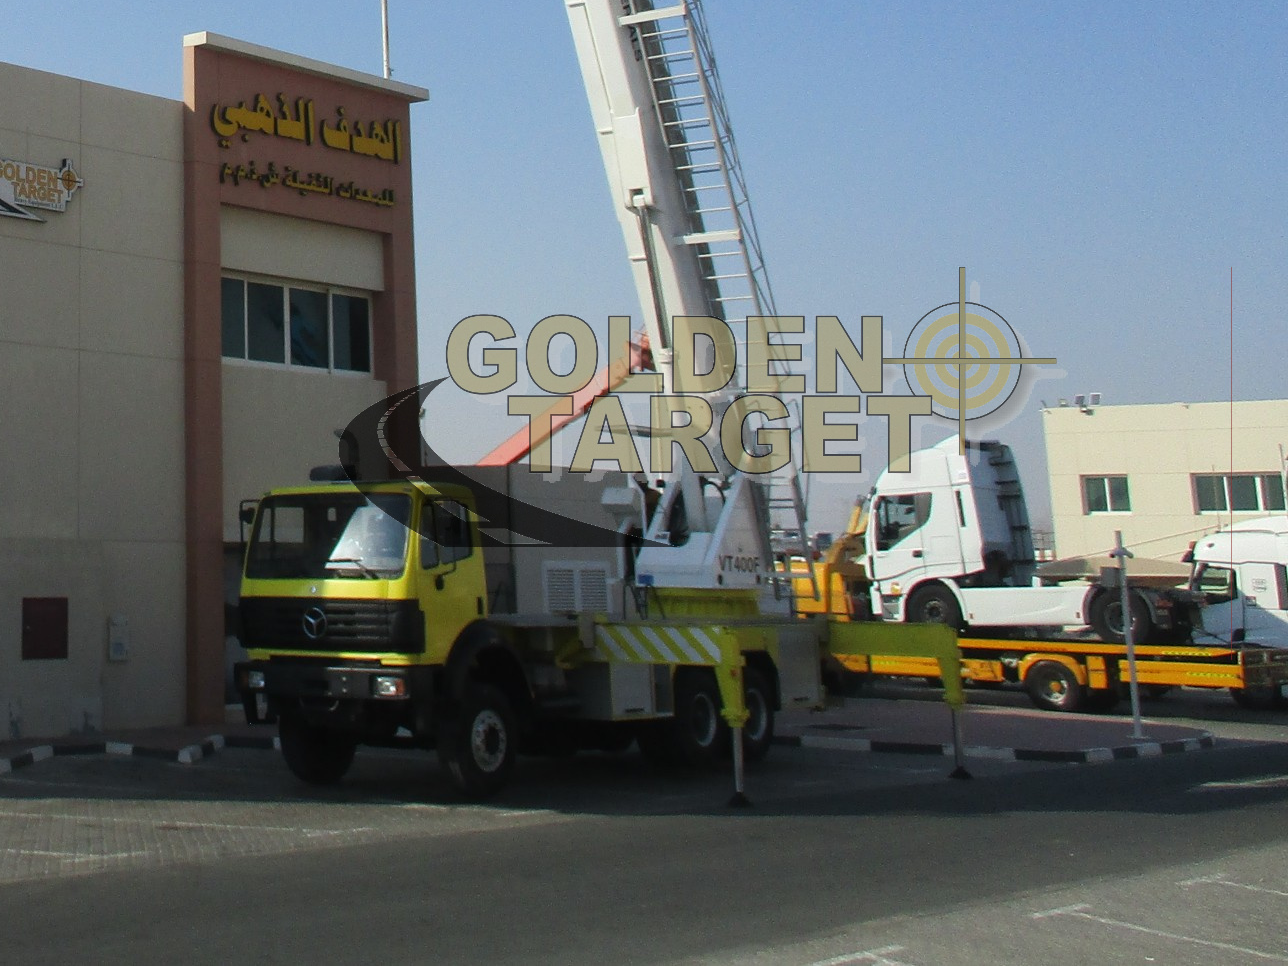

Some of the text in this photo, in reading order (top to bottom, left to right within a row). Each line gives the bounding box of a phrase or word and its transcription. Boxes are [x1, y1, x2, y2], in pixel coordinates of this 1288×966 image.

[211, 92, 402, 165] الهدف الذهبي
[11, 182, 64, 203] TARGET
